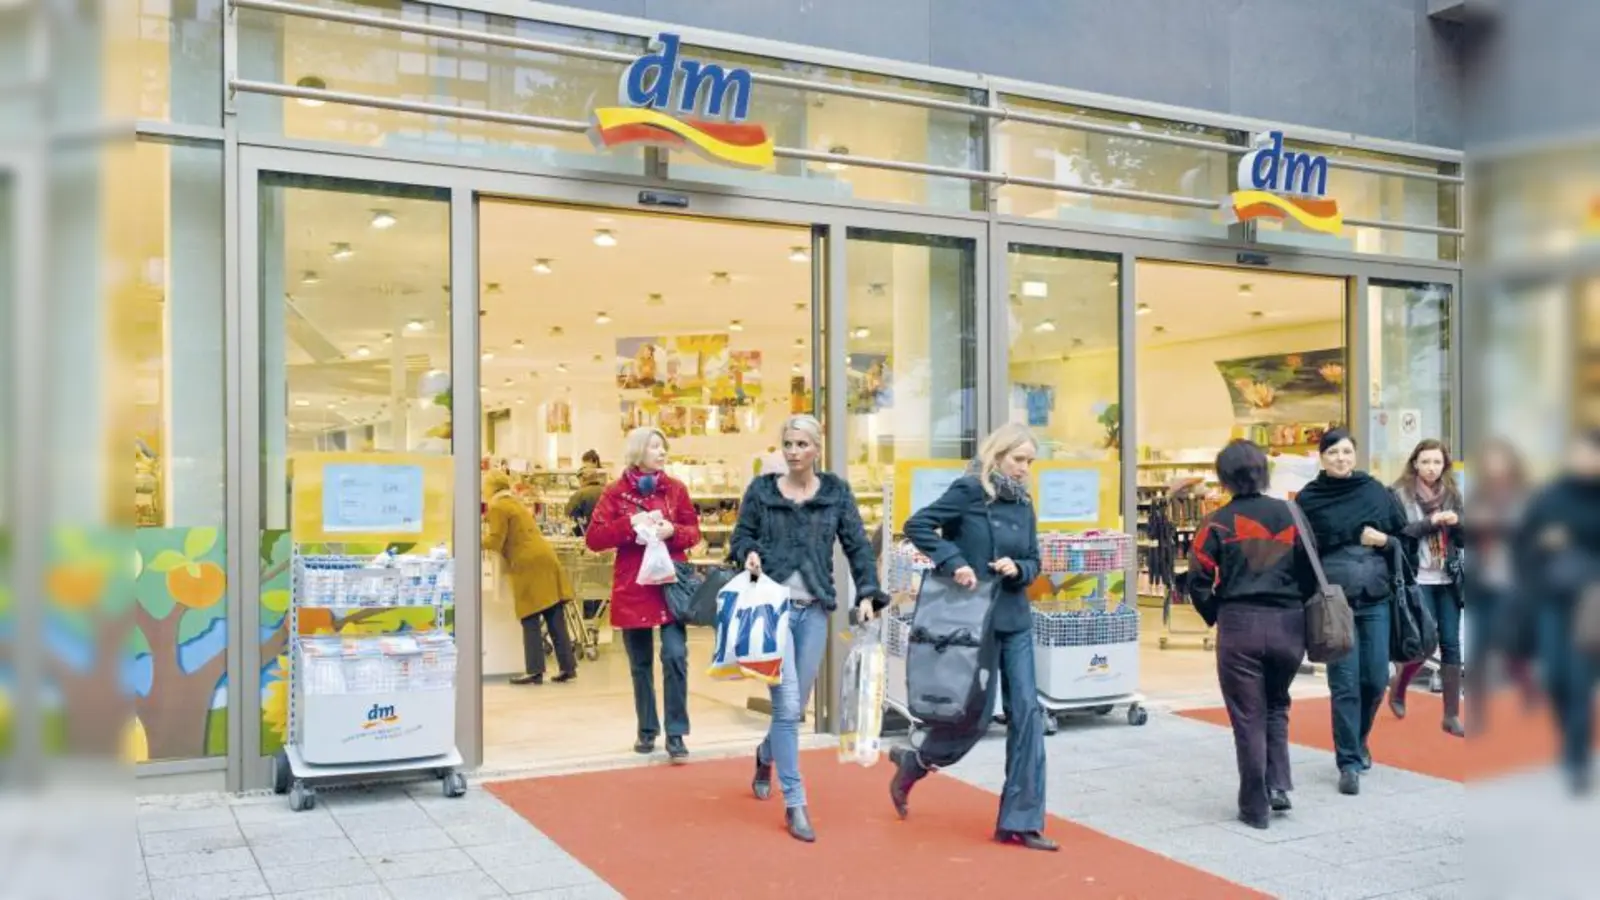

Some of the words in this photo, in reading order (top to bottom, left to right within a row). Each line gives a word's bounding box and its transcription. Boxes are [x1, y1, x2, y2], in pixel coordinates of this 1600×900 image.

[626, 32, 752, 119] dm
[1252, 131, 1327, 195] dm
[367, 703, 394, 720] dm
